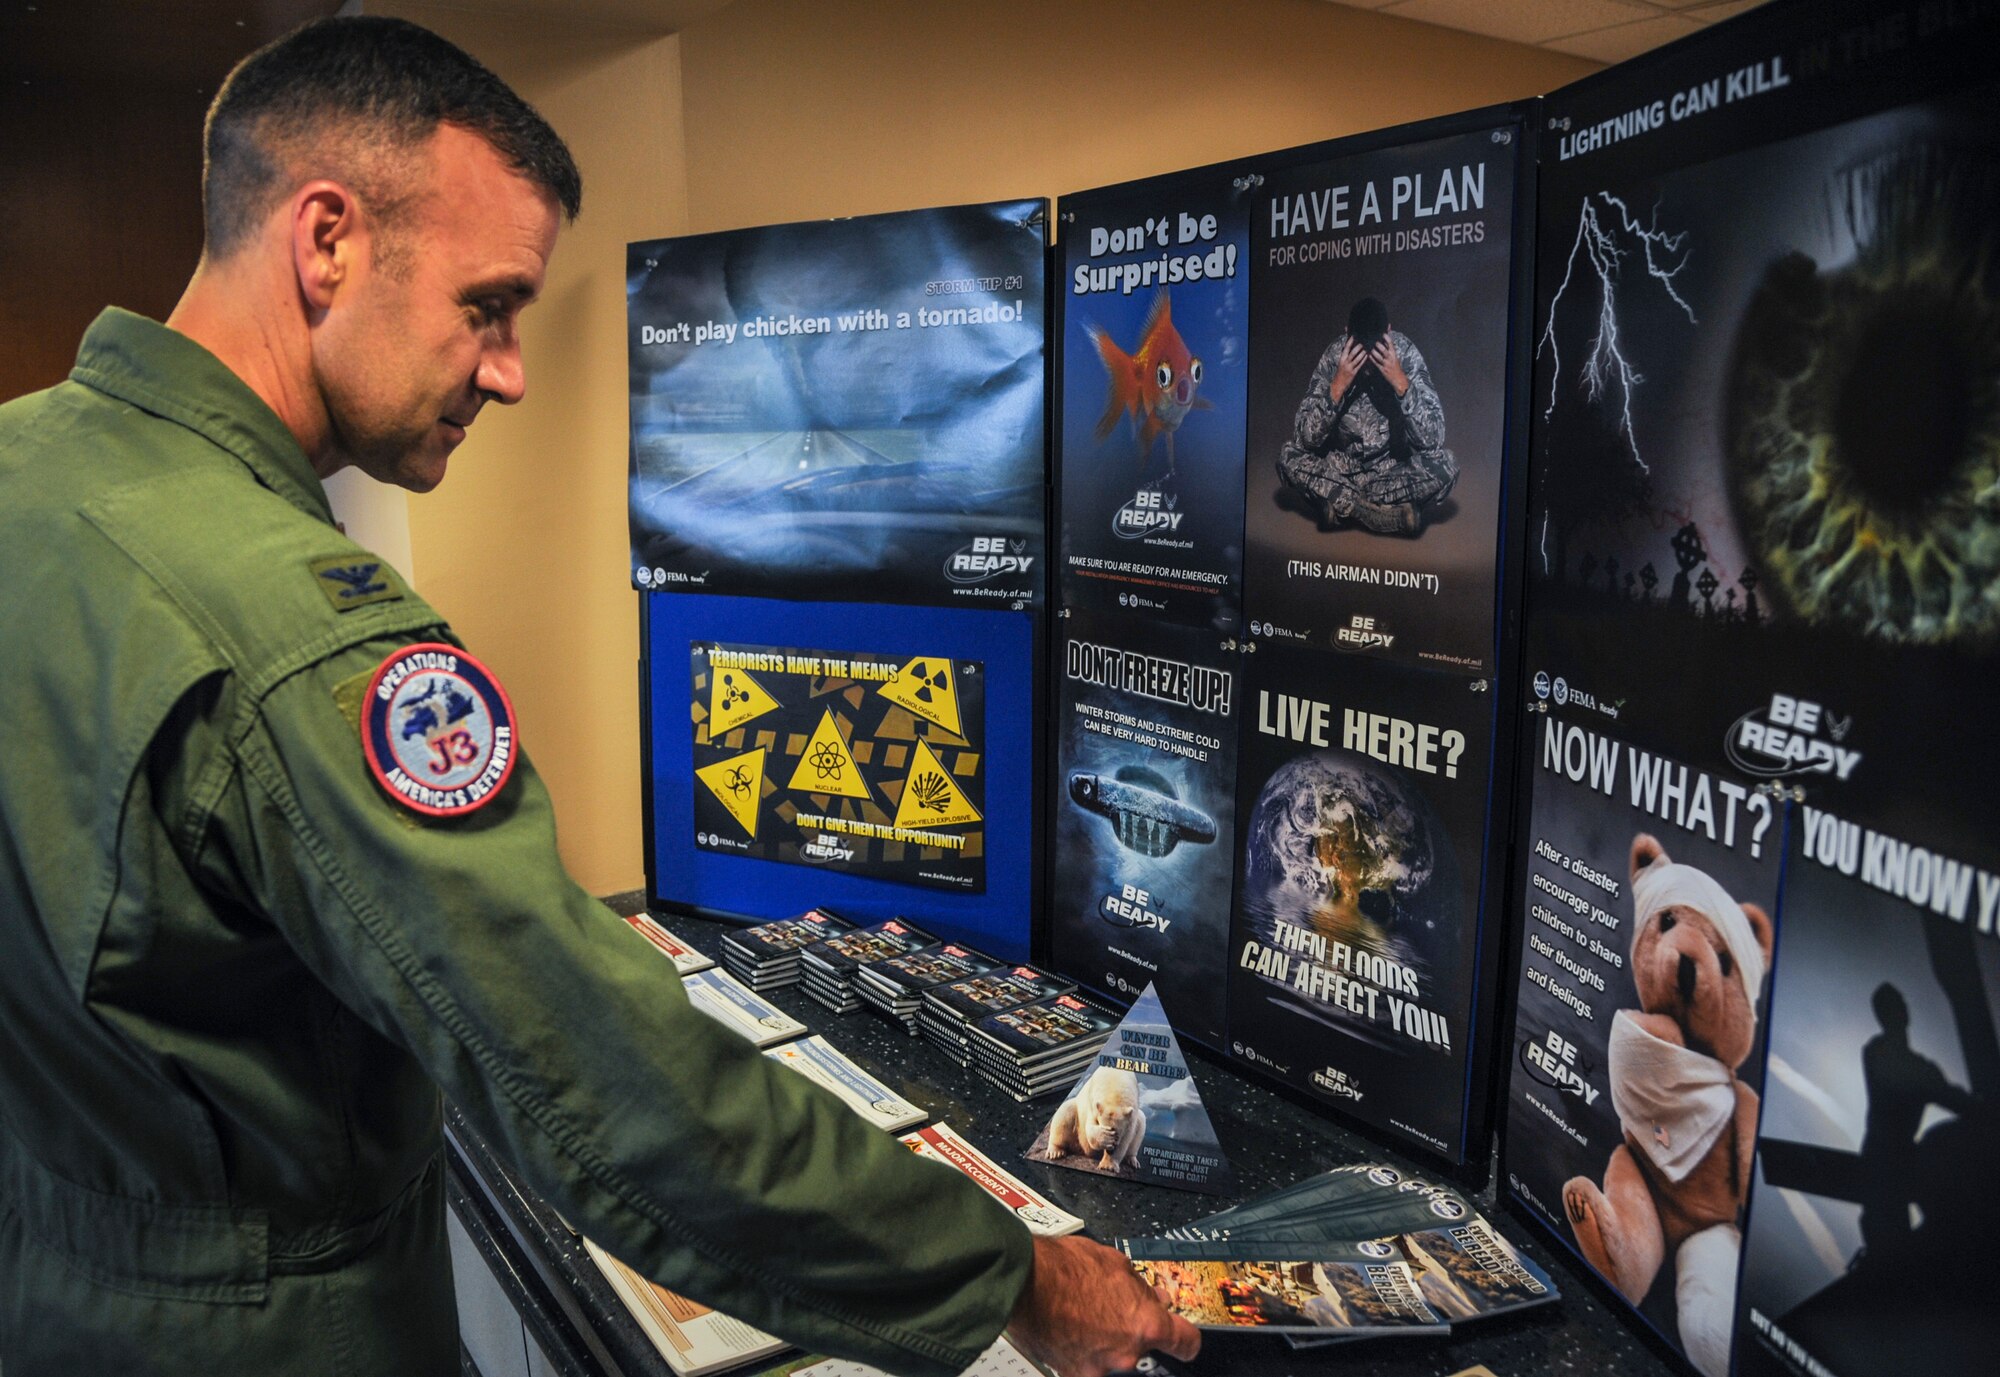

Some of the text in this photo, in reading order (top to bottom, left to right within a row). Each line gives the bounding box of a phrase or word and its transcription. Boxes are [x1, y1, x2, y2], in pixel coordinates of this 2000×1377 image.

[1559, 55, 1791, 162] LIGHTNING CAN KILL
[1271, 163, 1485, 238] HAVE A PLAN
[1090, 212, 1217, 257] Don't be
[1270, 221, 1484, 266] FOR COPING WITH DISASTERS
[1073, 243, 1237, 295] Surprised!
[926, 276, 1022, 295] STORM TIP #1
[642, 300, 1023, 345] Don't play chicken with a tornado!
[1136, 491, 1162, 509] BE
[1120, 510, 1183, 531] READY
[972, 537, 1005, 553] BE
[1144, 538, 1194, 549] www.BeReady.af.mil
[667, 572, 705, 584] FEMA Ready
[953, 555, 1033, 573] READY
[1069, 555, 1228, 585] MAKE SURE YOU ARE READY FOR AN EMERGENCY.
[1287, 560, 1439, 595] (THIS AIRMAN DIDN'T)
[952, 587, 1032, 599] www.BeReady.af.mil
[1139, 599, 1153, 607] FEMA
[1274, 627, 1293, 637] FEMA
[1338, 628, 1394, 647] READY
[1351, 616, 1375, 630] BE
[708, 649, 899, 683] TERRORISTS HAVE THE MEANS
[1419, 651, 1482, 666] www.BeReady.af.mil
[377, 652, 457, 700] OPERATIONS
[1067, 640, 1232, 716] DON'T FREEZE UP!
[728, 712, 754, 726] CHEMICAL
[896, 695, 940, 722] RADIOLOGICAL
[1569, 688, 1619, 719] FEMA Ready
[1768, 693, 1822, 733] BE
[1075, 702, 1220, 749] WINTER STORMS AND EXTREME COLD
[1084, 720, 1207, 762] CAN BE VERY HARD TO HANDLE!
[1259, 689, 1465, 779] LIVE HERE?
[429, 728, 479, 775] J3
[1739, 721, 1863, 781] READY
[386, 726, 511, 808] AMERICA'S DEFENDER
[814, 784, 842, 793] NUCLEAR
[1544, 717, 1773, 858] NOW WHAT?
[796, 813, 966, 850] DON'T GIVE THEM THE OPPORTUNITY
[902, 814, 971, 827] HIGH-YIELD EXPLOSIVE
[719, 838, 736, 847] FEMA
[805, 845, 854, 861] READY
[818, 834, 838, 848] BE
[1535, 840, 1620, 898] After a disaster,
[1802, 805, 2000, 942] YOU KNOW Y
[1122, 883, 1150, 907] BE
[1533, 873, 1619, 930] encourage your
[1105, 896, 1171, 933] READY
[1532, 905, 1622, 968] children to share
[1273, 919, 1419, 997] THEN FLOODS
[1530, 934, 1605, 991] their thoughts
[1128, 985, 1144, 996] FEM
[1240, 941, 1290, 982] CAN
[1293, 963, 1379, 1020] AFFECT
[1527, 966, 1593, 1020] and feelings.
[1120, 1045, 1167, 1062] CAN BE
[1121, 1030, 1170, 1048] WINTER
[1546, 1030, 1577, 1066] BE
[1100, 1055, 1187, 1079] UNBEARABLE!
[1256, 1054, 1273, 1067] FEMA
[1326, 1066, 1347, 1083] BE
[1527, 1042, 1599, 1106] READY
[1314, 1073, 1363, 1101] READY
[1525, 1092, 1588, 1147] www.BeReady.af.mil
[936, 1141, 1009, 1196] MAJOR ACCIDENTS
[1144, 1147, 1218, 1167] PREPAREDNESS TAKES
[1150, 1158, 1209, 1175] MORE THAN JUST
[1152, 1167, 1207, 1183] A WINTER COAT!
[1451, 1228, 1474, 1245] BE
[1468, 1225, 1546, 1293] EVERYONE SHOULD
